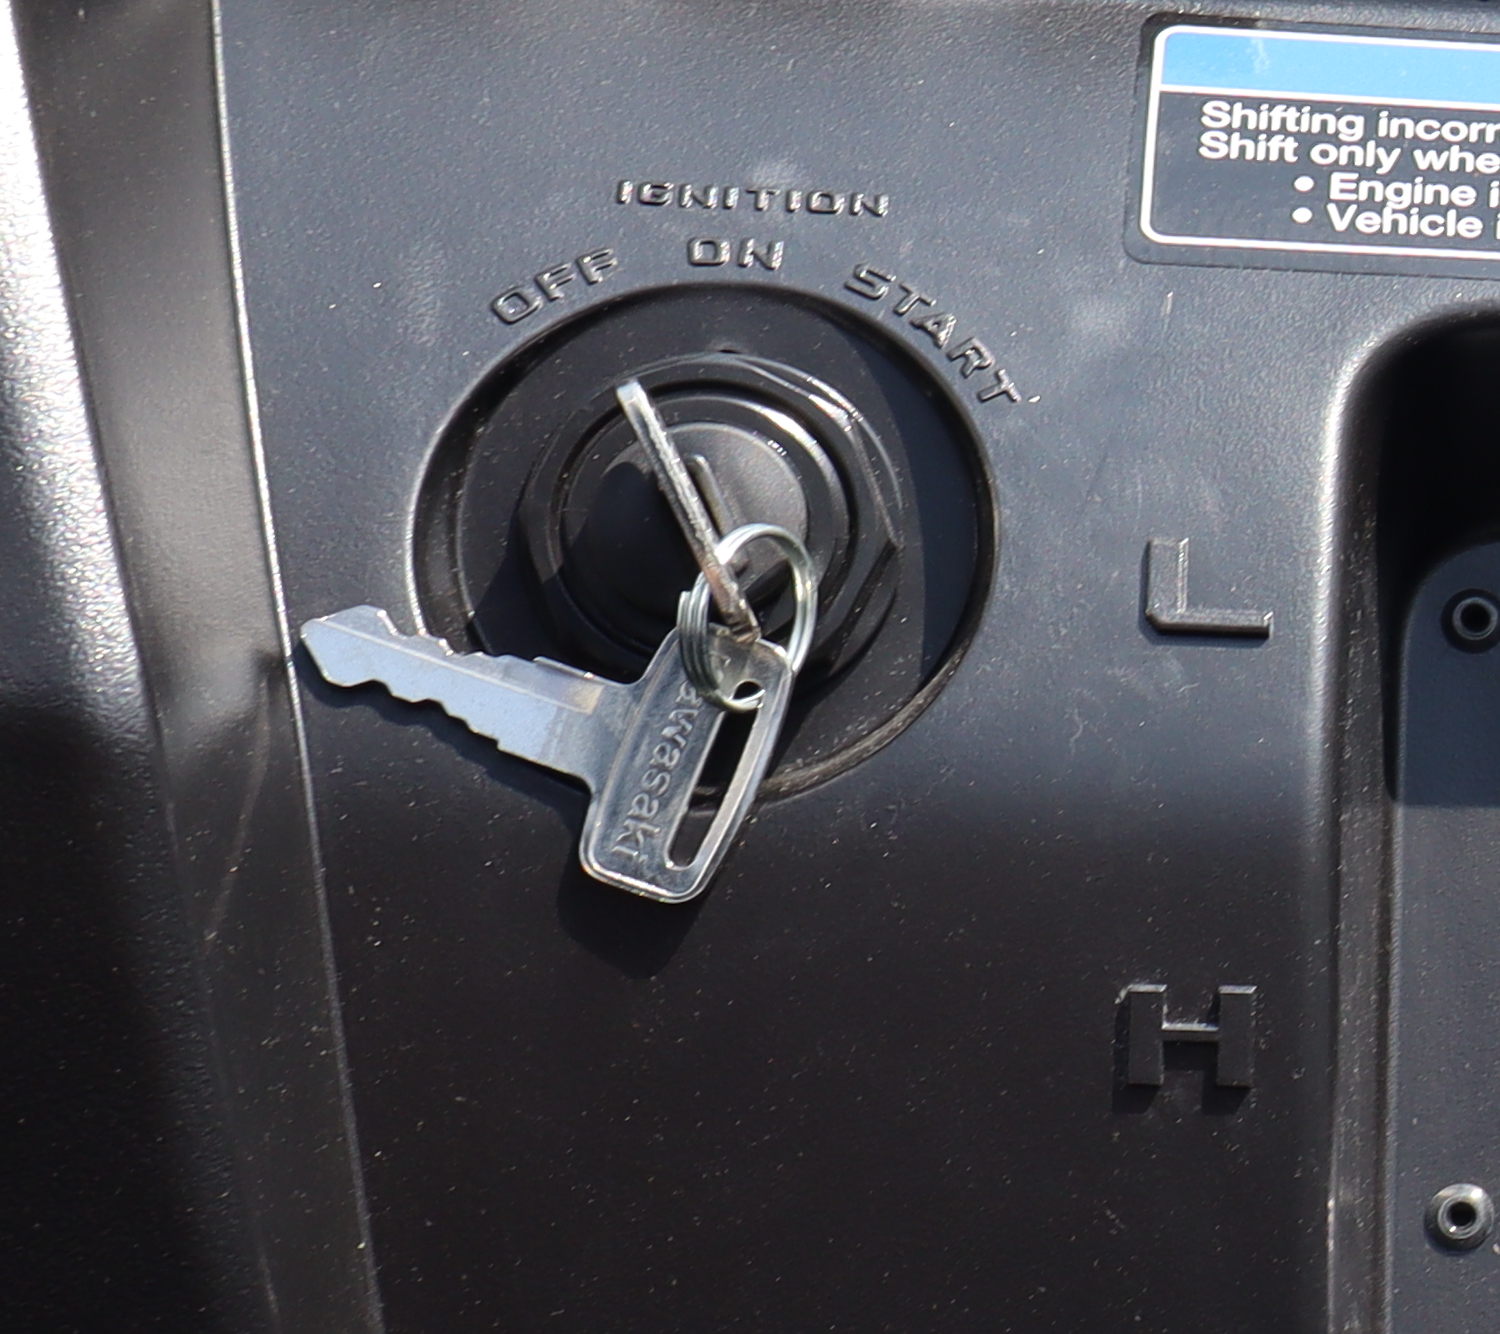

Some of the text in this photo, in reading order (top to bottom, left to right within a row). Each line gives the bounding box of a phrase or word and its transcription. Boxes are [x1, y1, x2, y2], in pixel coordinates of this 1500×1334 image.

[1200, 99, 1367, 143] Shifting
[1199, 130, 1298, 167] Shift
[1310, 139, 1402, 176] only
[615, 179, 890, 219] IGNITION
[1330, 175, 1479, 212] Engine
[1326, 203, 1484, 242] Vehicle
[685, 234, 785, 272] ON
[490, 247, 620, 328] OFF
[844, 263, 1025, 409] START
[1143, 535, 1273, 639] L
[611, 680, 704, 862] awasaki
[1126, 982, 1256, 1087] H
